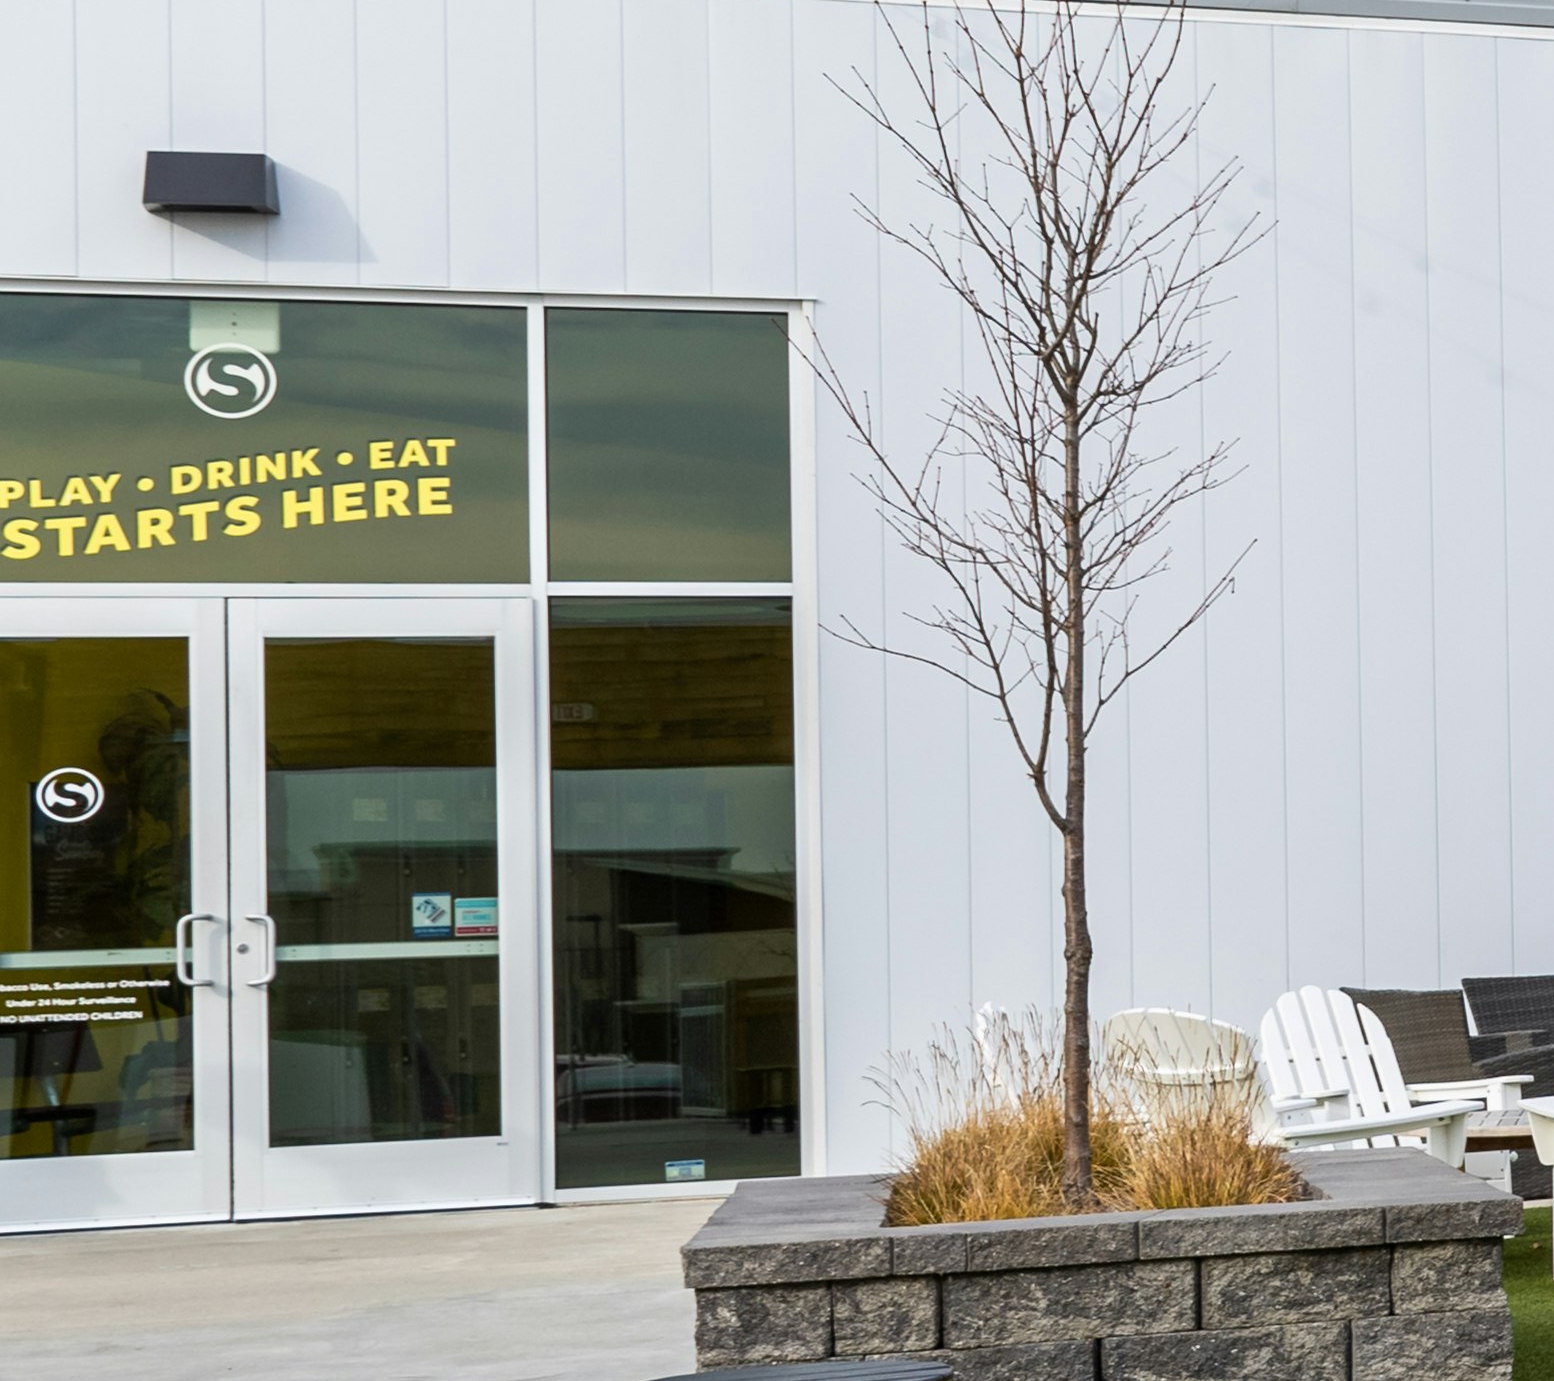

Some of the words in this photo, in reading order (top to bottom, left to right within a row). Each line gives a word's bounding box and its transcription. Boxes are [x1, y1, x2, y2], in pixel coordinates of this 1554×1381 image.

[0, 474, 121, 509] PLAY
[170, 447, 322, 495] DRINK
[369, 438, 456, 470] EAT
[1, 494, 262, 560] STARTS
[282, 477, 453, 529] HERE
